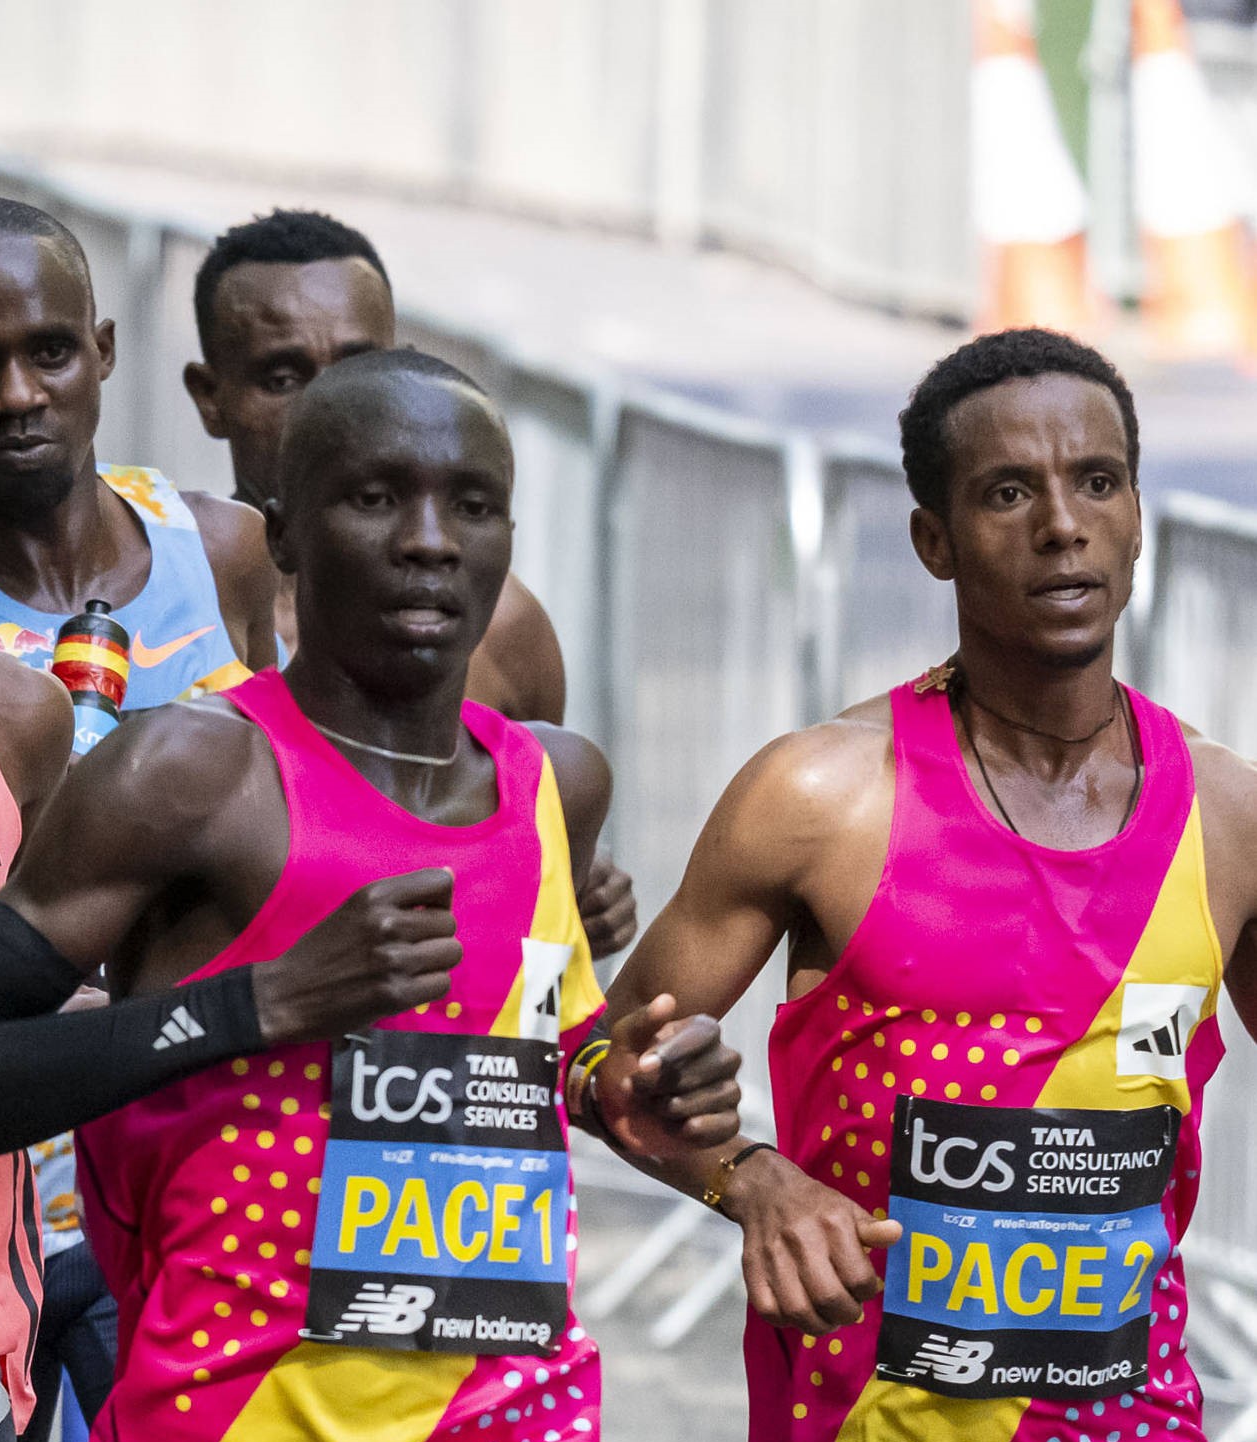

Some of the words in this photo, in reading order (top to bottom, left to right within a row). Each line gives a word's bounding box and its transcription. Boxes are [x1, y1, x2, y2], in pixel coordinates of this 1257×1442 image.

[465, 1054, 519, 1078] TATA
[351, 1050, 453, 1124] tcs
[463, 1105, 538, 1131] SERVICES
[1030, 1127, 1096, 1147] TATA
[910, 1117, 1016, 1192] tcs
[1028, 1148, 1164, 1172] CONSULTANCY
[1026, 1175, 1121, 1195] SERVICES
[338, 1175, 526, 1263] PACE
[907, 1231, 1107, 1317] PACE
[1118, 1240, 1155, 1315] 2
[432, 1316, 476, 1339] new
[476, 1314, 551, 1343] balance
[992, 1366, 1041, 1385] new
[1046, 1359, 1132, 1388] balance
